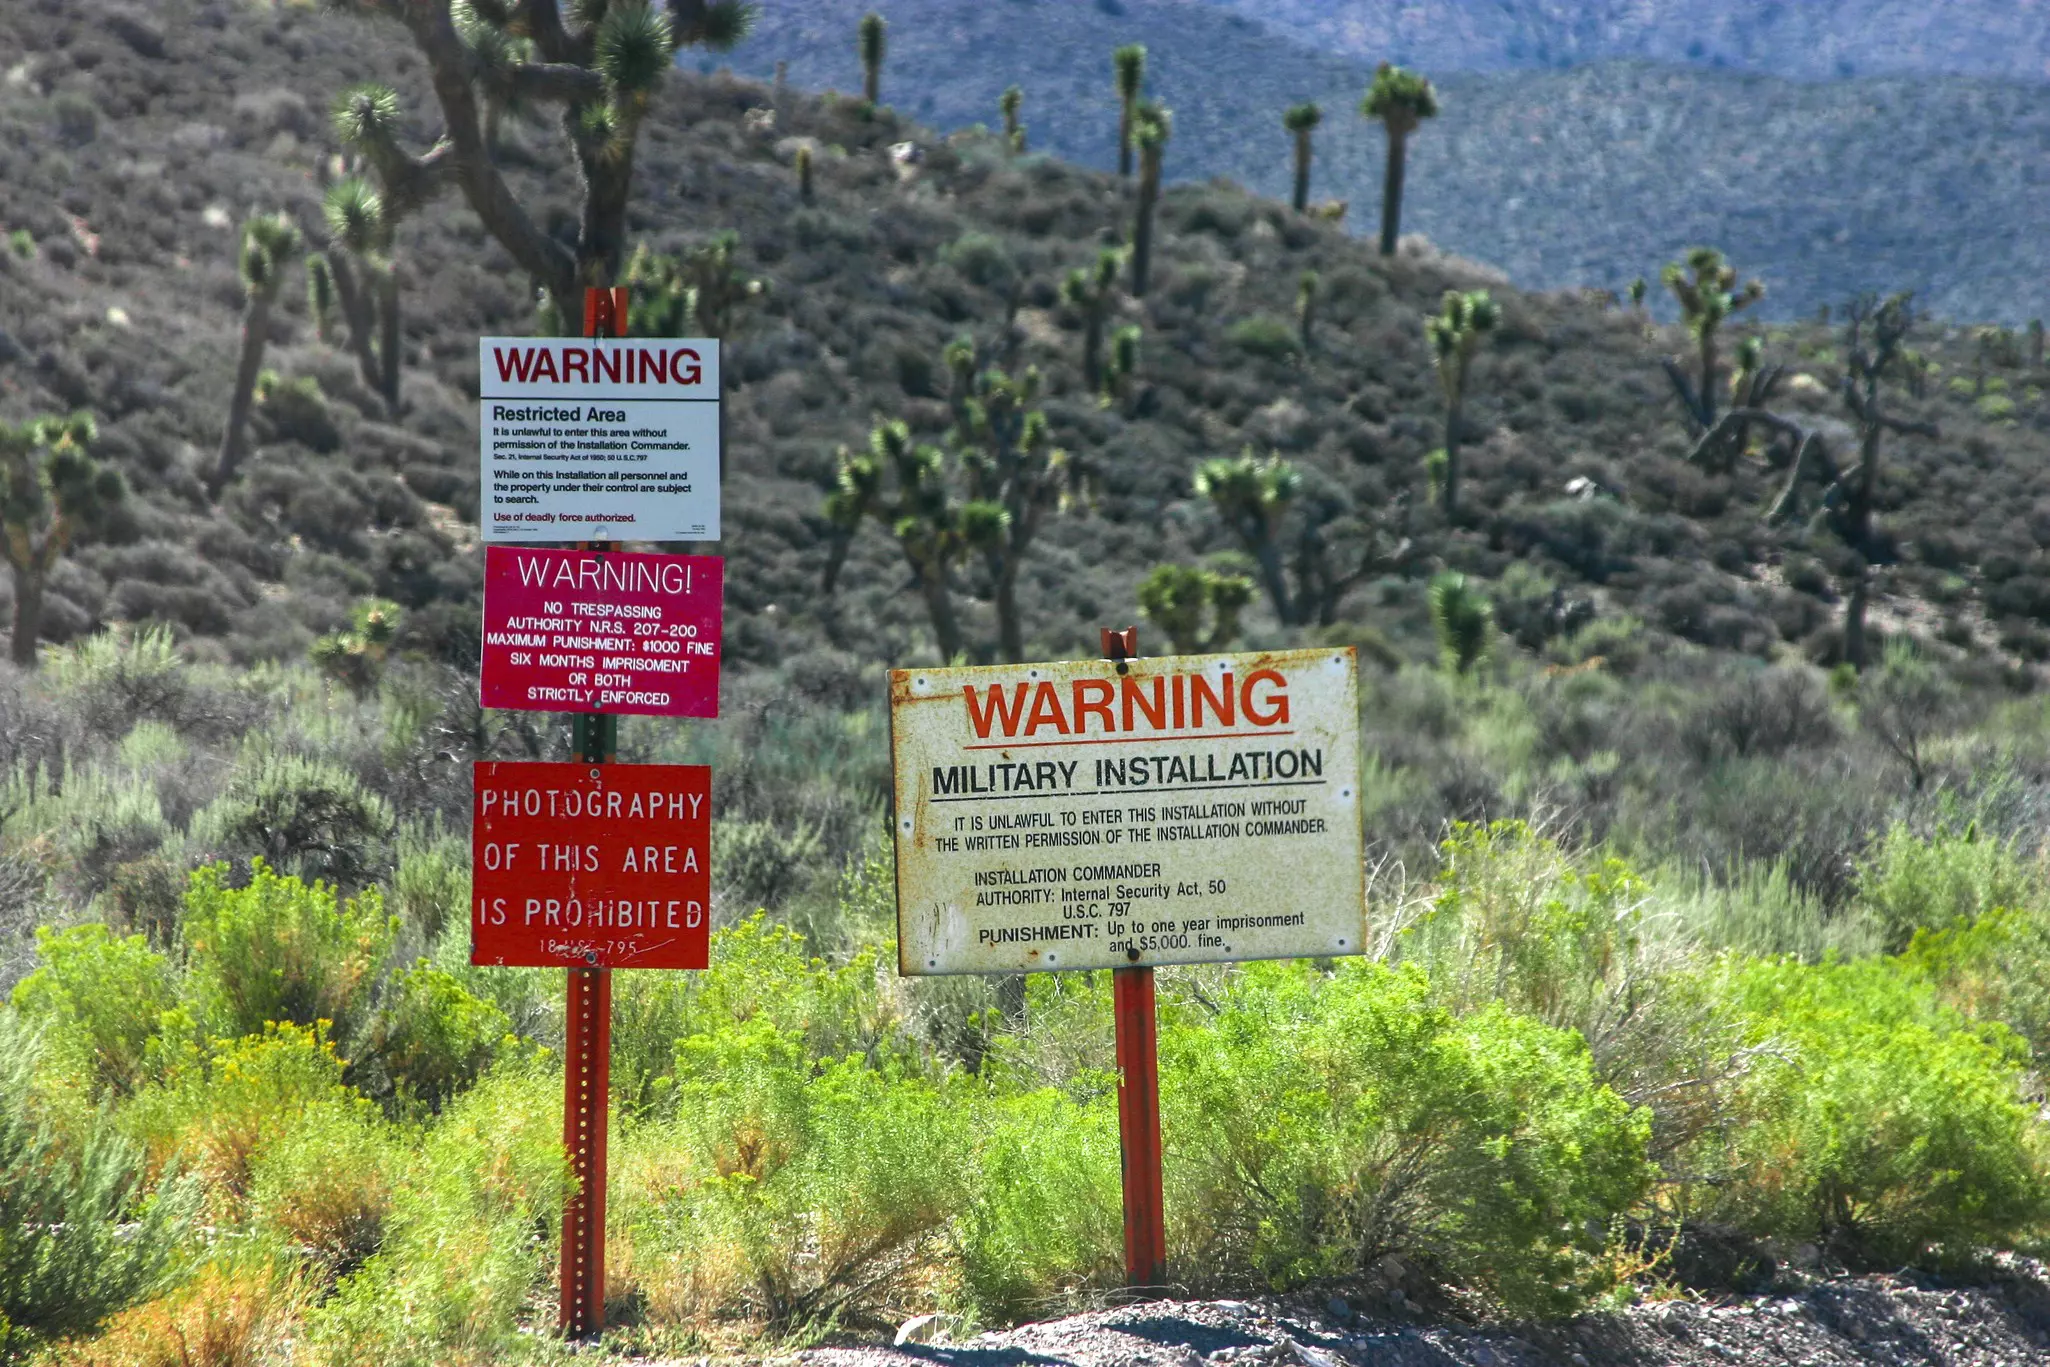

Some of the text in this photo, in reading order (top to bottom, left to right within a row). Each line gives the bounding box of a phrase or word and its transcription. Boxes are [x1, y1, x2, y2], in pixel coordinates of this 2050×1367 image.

[493, 347, 701, 385] WARNING
[493, 406, 626, 422] Restricted Area
[493, 428, 500, 436] It
[501, 428, 509, 436] is
[512, 428, 551, 437] unlawful
[553, 429, 563, 437] to
[590, 428, 608, 437] this
[632, 429, 667, 438] without
[494, 441, 690, 450] permission of the Installation Commander.
[494, 470, 520, 479] While
[536, 471, 553, 480] this
[556, 471, 606, 480] Installation
[608, 472, 619, 480] all
[621, 472, 668, 482] personnel
[670, 472, 688, 480] and
[494, 483, 692, 494] the property under their control are subject
[505, 495, 539, 504] search.
[494, 513, 636, 524] Use of deadly force authorized.
[518, 556, 691, 594] WARNING!
[544, 602, 662, 619] NO TRESPASSING
[507, 617, 697, 637] AUTHORITY N.R.S. 207-200
[487, 633, 714, 656] MAXIMUM PUNISHMENT: $1000 FINE
[511, 653, 690, 673] SIX MONTHS IMPRISOMENT
[569, 673, 631, 687] OR BOTH
[528, 687, 670, 706] STRICTLY ENFORCED
[963, 668, 1290, 740] WARNING
[933, 749, 1323, 795] MILITARY INSTALLATION
[482, 789, 703, 819] PHOTOGRAPHY
[954, 800, 1306, 832] IT IS UNLAWFUL TO ENTER THIS INSTALLATION WITHOUT
[936, 819, 1328, 853] THE WRITTEN PERMISSION OF THE INSTALLATION COMMANDER.
[485, 843, 699, 874] OF THIS AREA
[975, 863, 1161, 886] INSTALLATION COMMANDER
[976, 880, 1226, 906] AUTHORITY: Internal Security Act, 50
[481, 898, 702, 929] IS PROHIBITED
[1063, 903, 1131, 920] U.S.C. 797
[979, 912, 1305, 944] PUNISHMENT: Up to one year imprisonment
[1109, 934, 1226, 953] and $5,000. fine.
